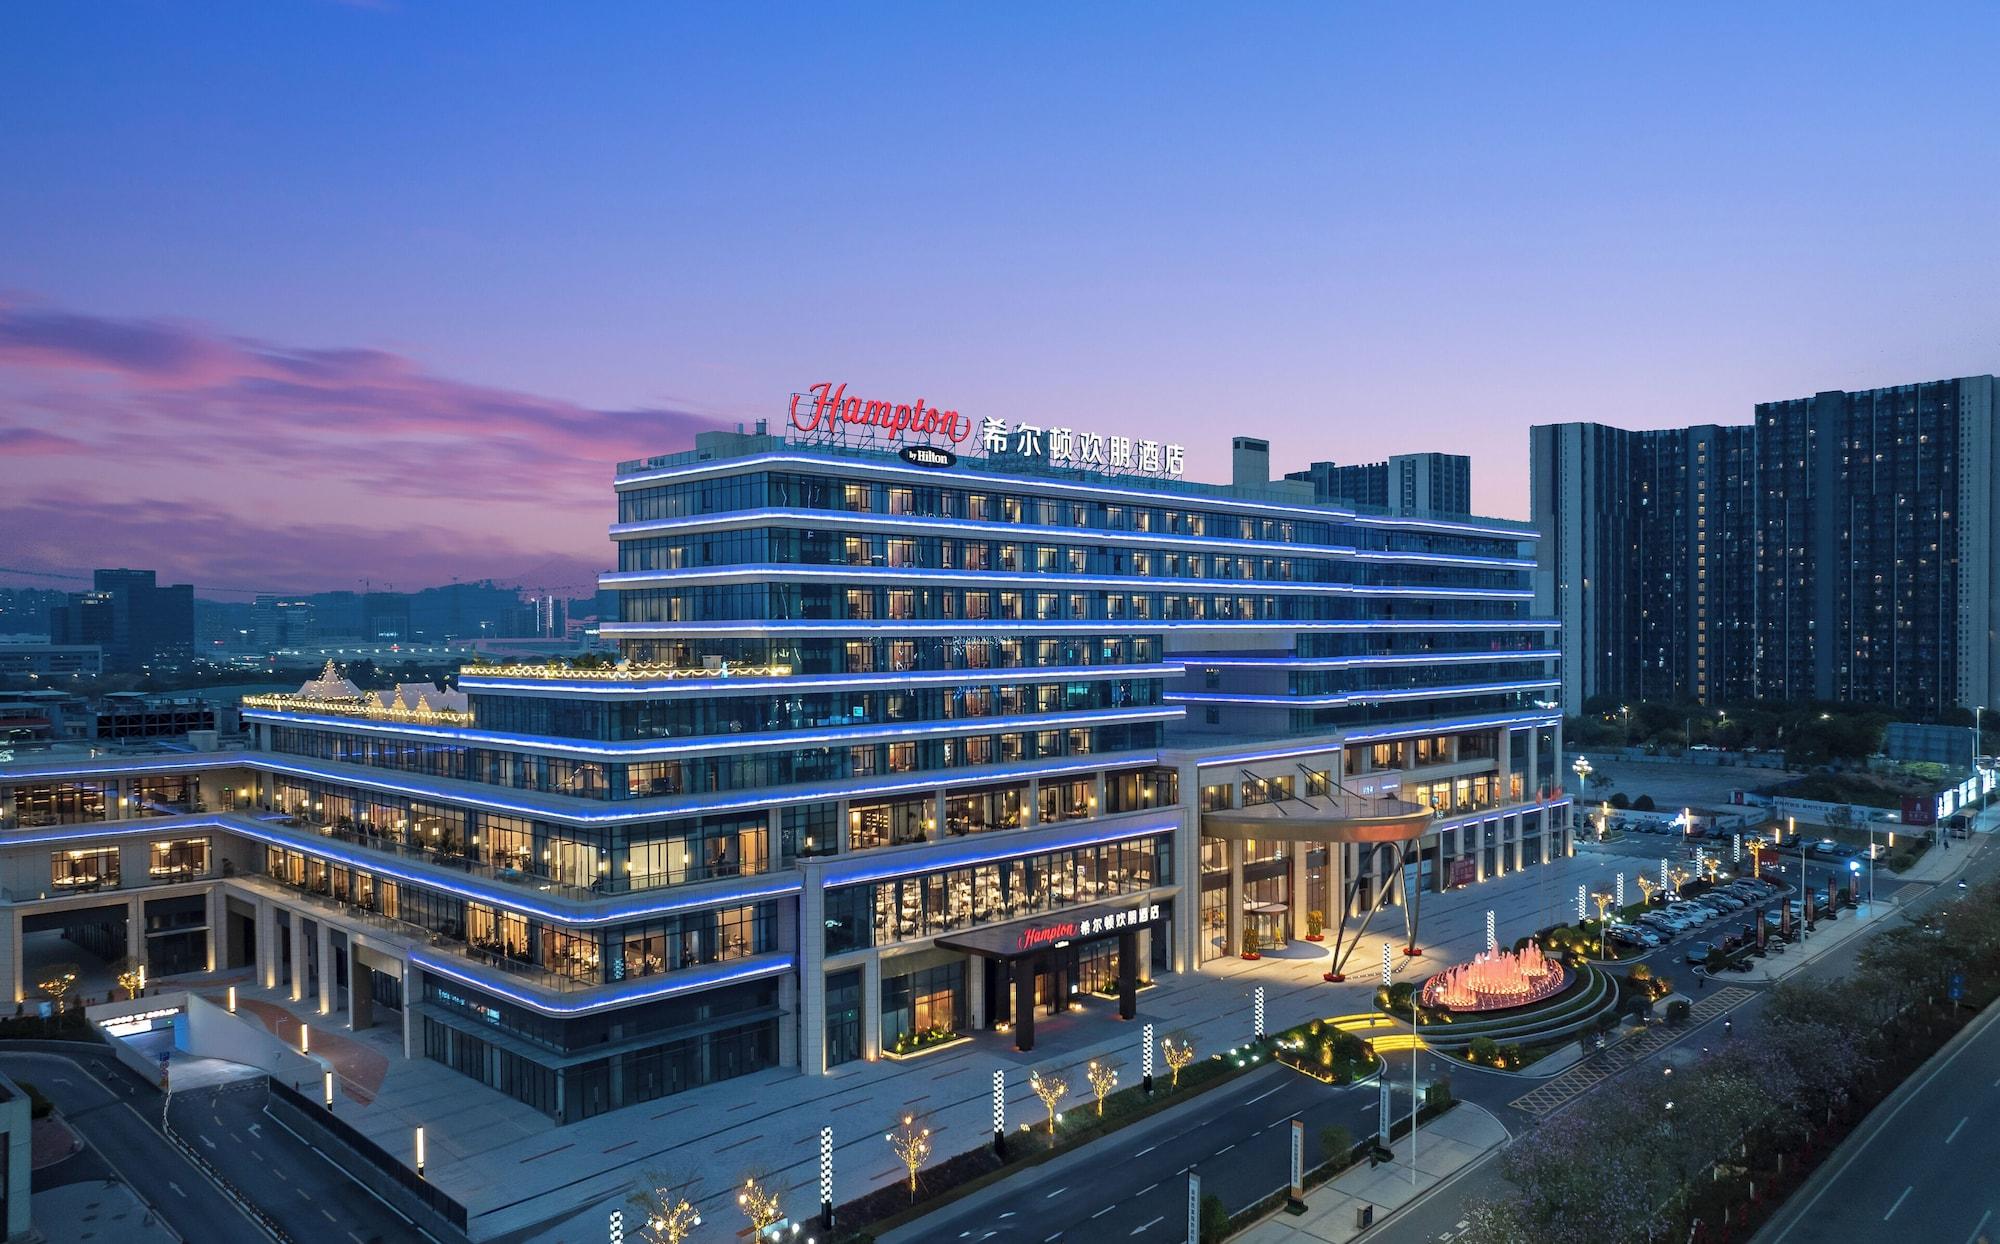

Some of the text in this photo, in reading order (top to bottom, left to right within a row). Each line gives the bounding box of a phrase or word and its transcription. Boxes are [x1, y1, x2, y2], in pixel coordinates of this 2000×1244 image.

[791, 382, 971, 442] Hampton
[908, 449, 949, 465] by Hilton
[983, 416, 1185, 475] 希尔顿欢朋酒店
[1017, 922, 1078, 950] Hampton
[1080, 904, 1160, 936] 希尔顿欢朋酒店
